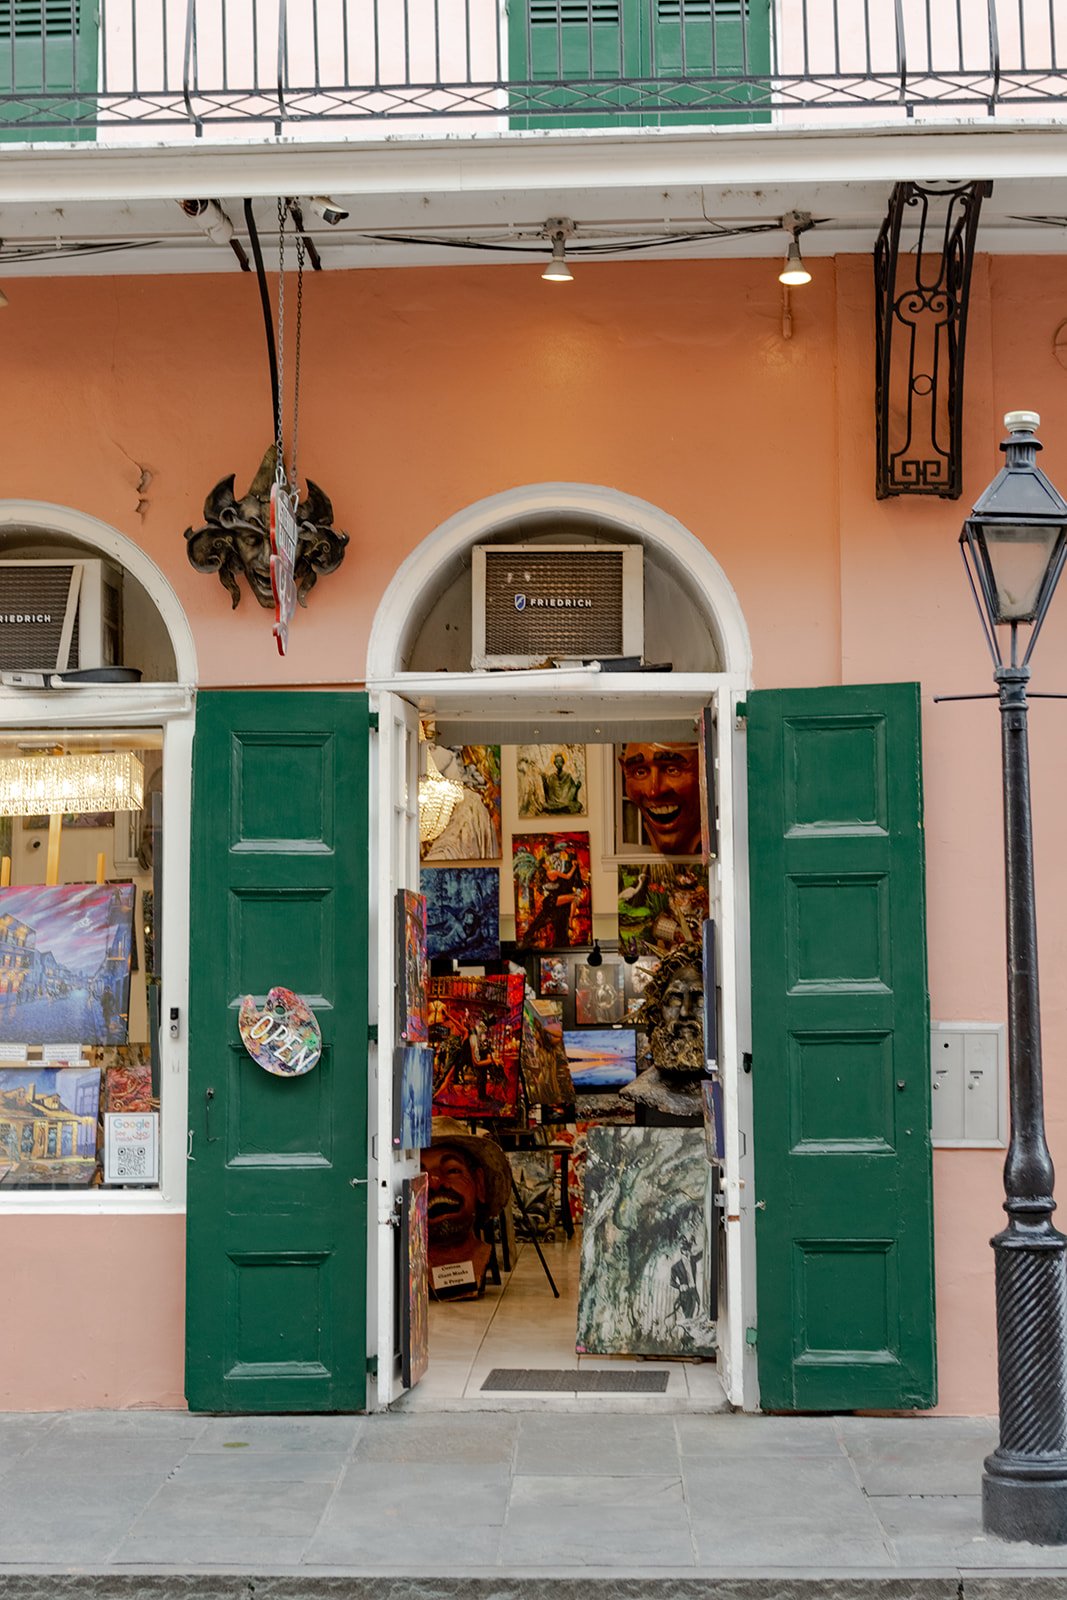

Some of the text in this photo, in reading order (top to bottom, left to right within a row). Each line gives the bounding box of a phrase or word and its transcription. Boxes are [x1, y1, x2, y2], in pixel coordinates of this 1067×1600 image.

[530, 598, 592, 607] FRIEDRICH
[250, 1015, 319, 1073] OPEN
[113, 1118, 150, 1131] Google
